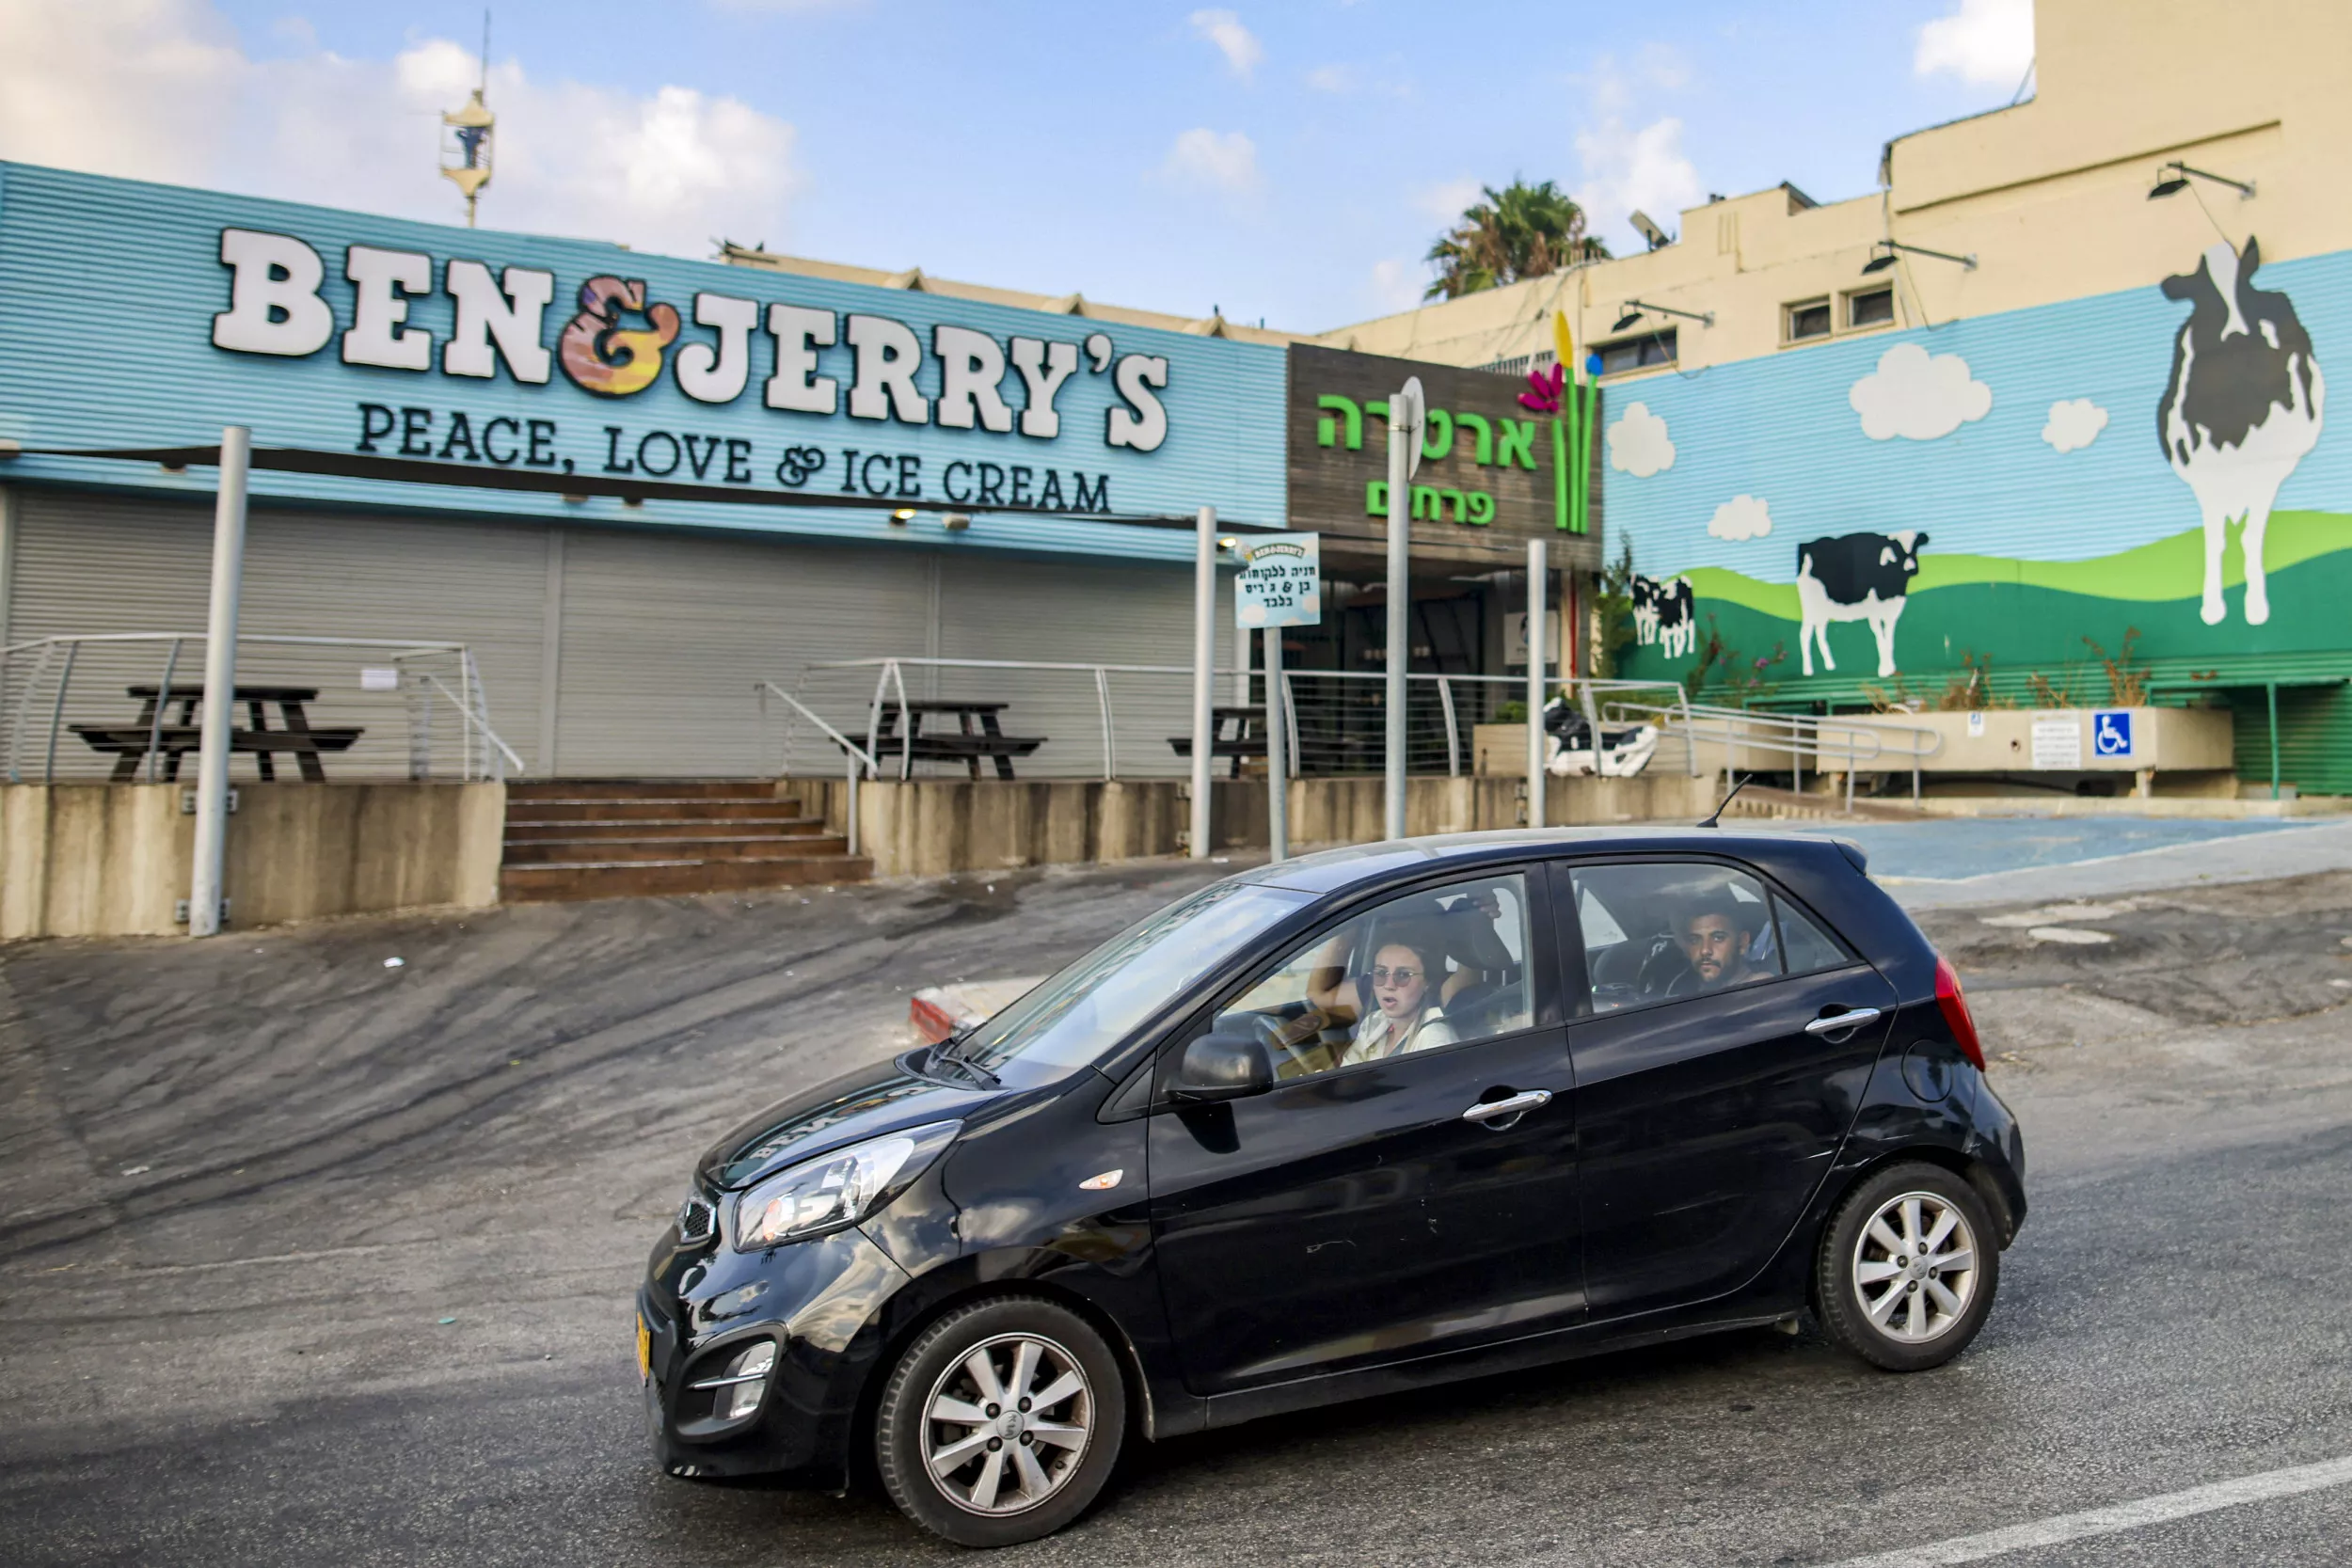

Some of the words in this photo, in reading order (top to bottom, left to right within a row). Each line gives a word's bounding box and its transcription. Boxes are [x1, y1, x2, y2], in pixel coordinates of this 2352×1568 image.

[356, 403, 576, 475] PEACE,
[604, 425, 753, 483] LOVE
[776, 445, 826, 487] &
[841, 449, 923, 497] ICE
[943, 461, 1112, 514] CREAM
[1366, 481, 1496, 525] פרחם
[1298, 581, 1311, 594] בן
